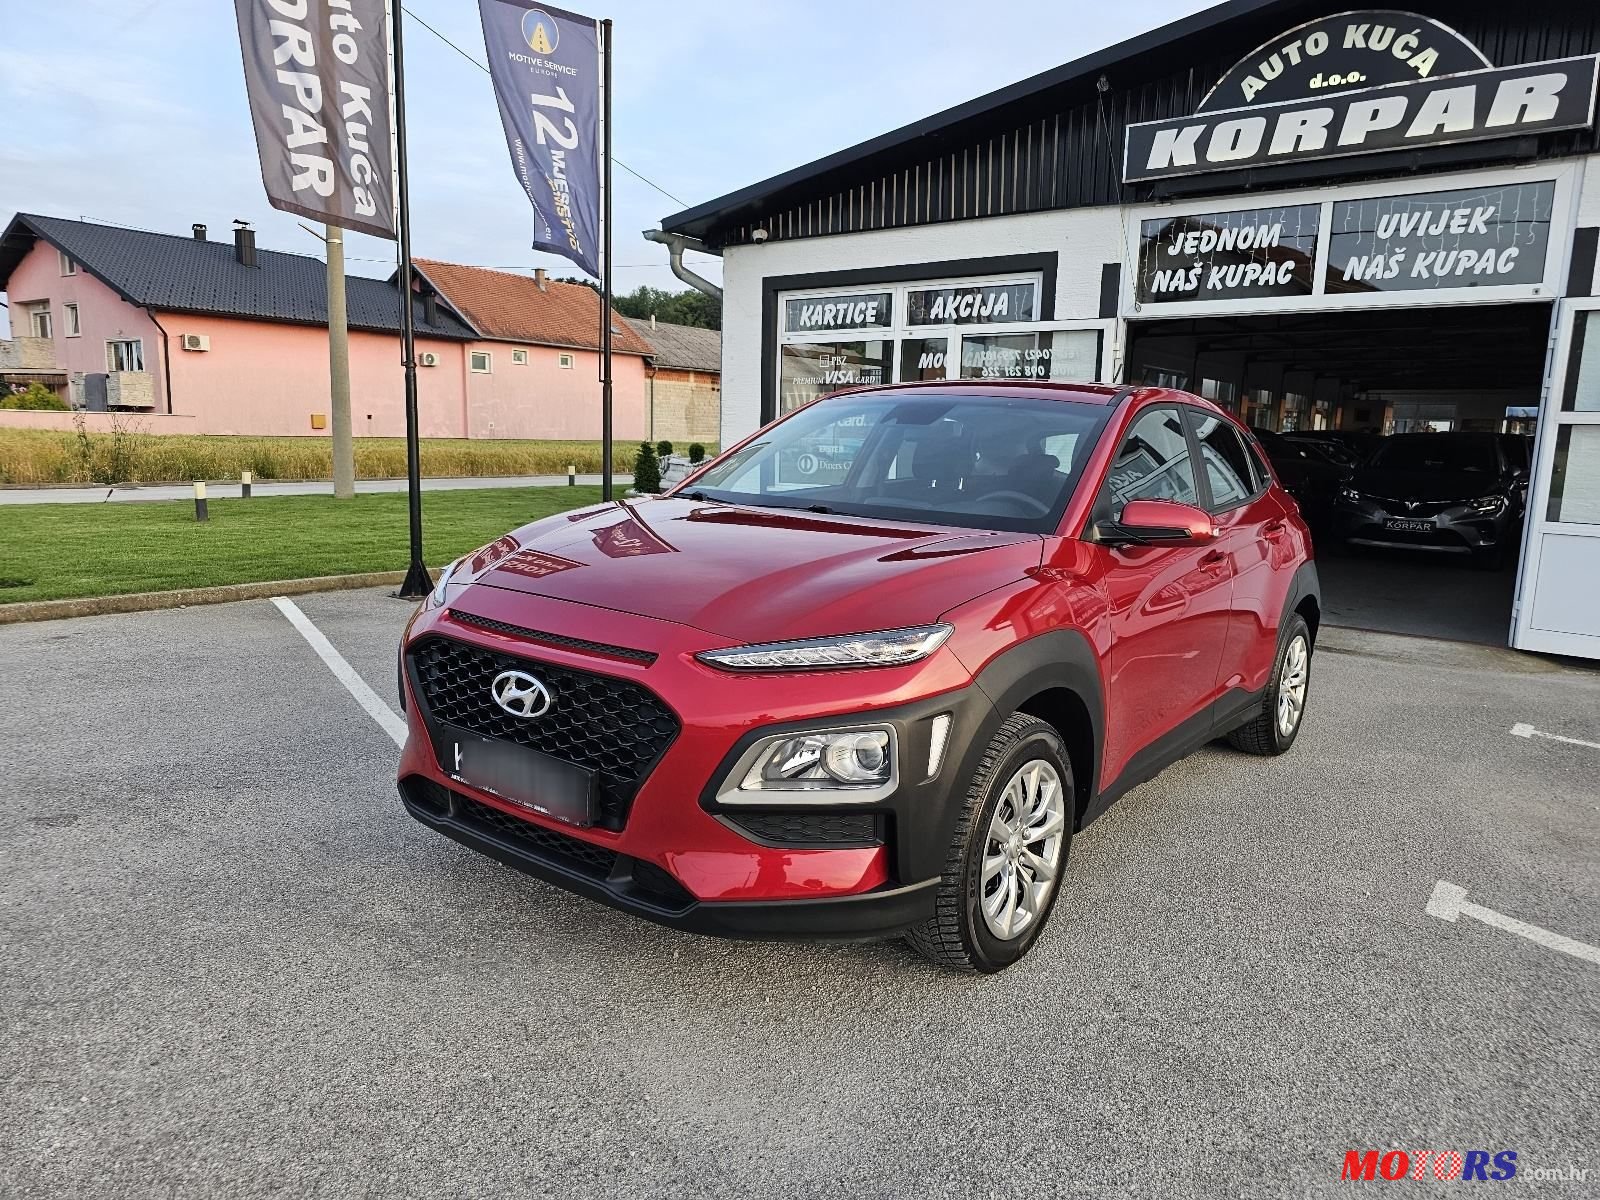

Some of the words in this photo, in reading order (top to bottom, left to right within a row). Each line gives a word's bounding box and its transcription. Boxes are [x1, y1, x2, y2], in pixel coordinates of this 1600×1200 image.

[508, 51, 543, 67] MOTIVE
[544, 60, 577, 76] SERVICE
[530, 67, 558, 79] EUROPE
[1240, 31, 1329, 103] AUTO
[1342, 23, 1440, 78] KUĆA
[1309, 71, 1367, 89] d.o.o.
[531, 86, 579, 150] 12
[1146, 73, 1568, 170] KORPAR
[339, 81, 379, 217] Kuća
[1167, 223, 1282, 256] JEDNOM
[1376, 206, 1496, 240] UVIJEK
[1151, 261, 1203, 293] NAŠ
[1206, 260, 1296, 290] KUPAC
[1343, 247, 1407, 281] NAŠ
[1410, 247, 1519, 279] KUPAC
[799, 301, 878, 327] KARTICE
[930, 292, 1009, 319] AKCIJA
[792, 376, 824, 385] PREMIUM
[825, 370, 855, 385] VISA
[855, 375, 876, 384] CARD
[1386, 520, 1431, 530] KORPAR
